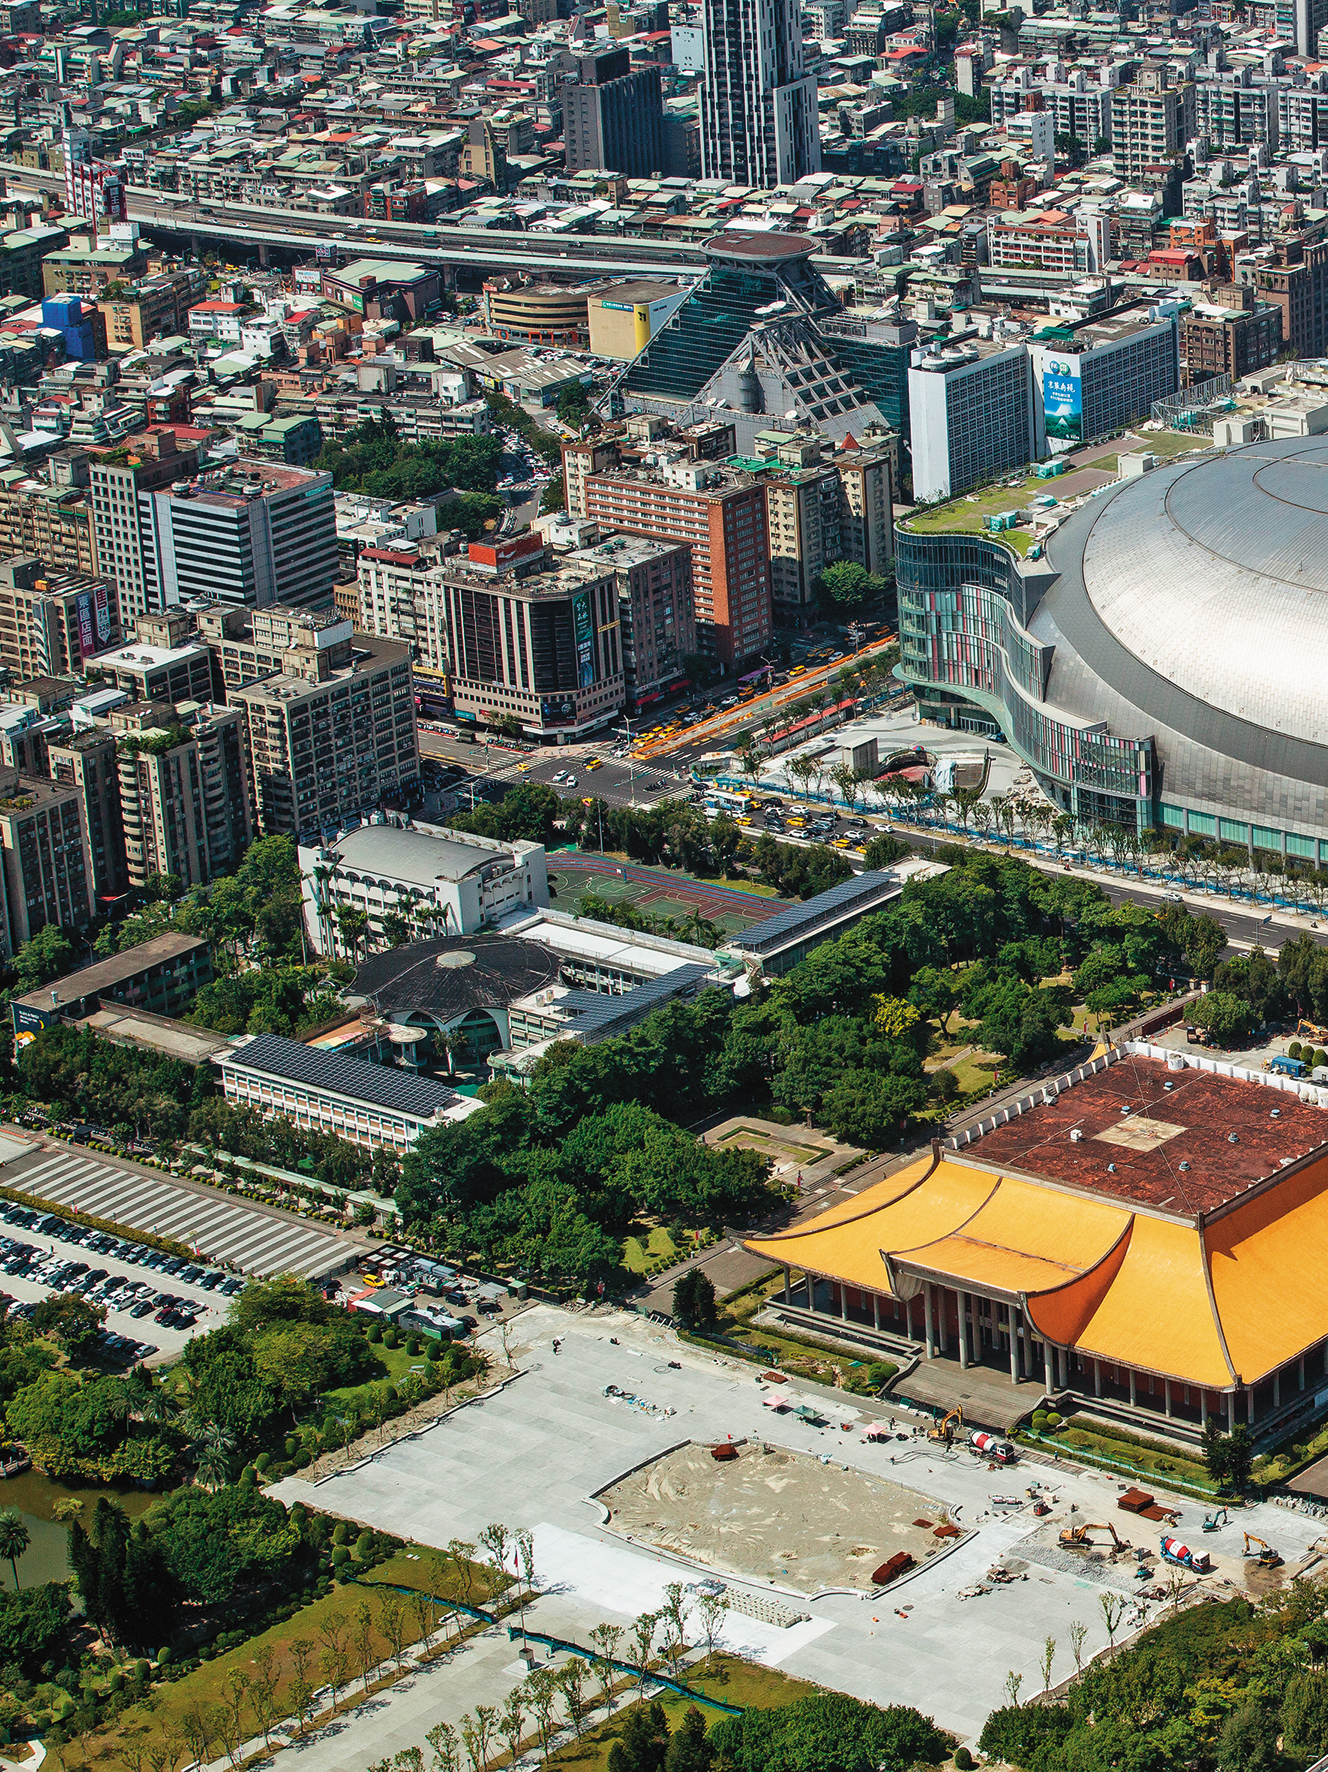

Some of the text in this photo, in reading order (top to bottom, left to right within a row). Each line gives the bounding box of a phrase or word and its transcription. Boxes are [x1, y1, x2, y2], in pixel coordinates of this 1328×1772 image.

[96, 588, 106, 609] 售
[77, 595, 93, 647] 東區店面
